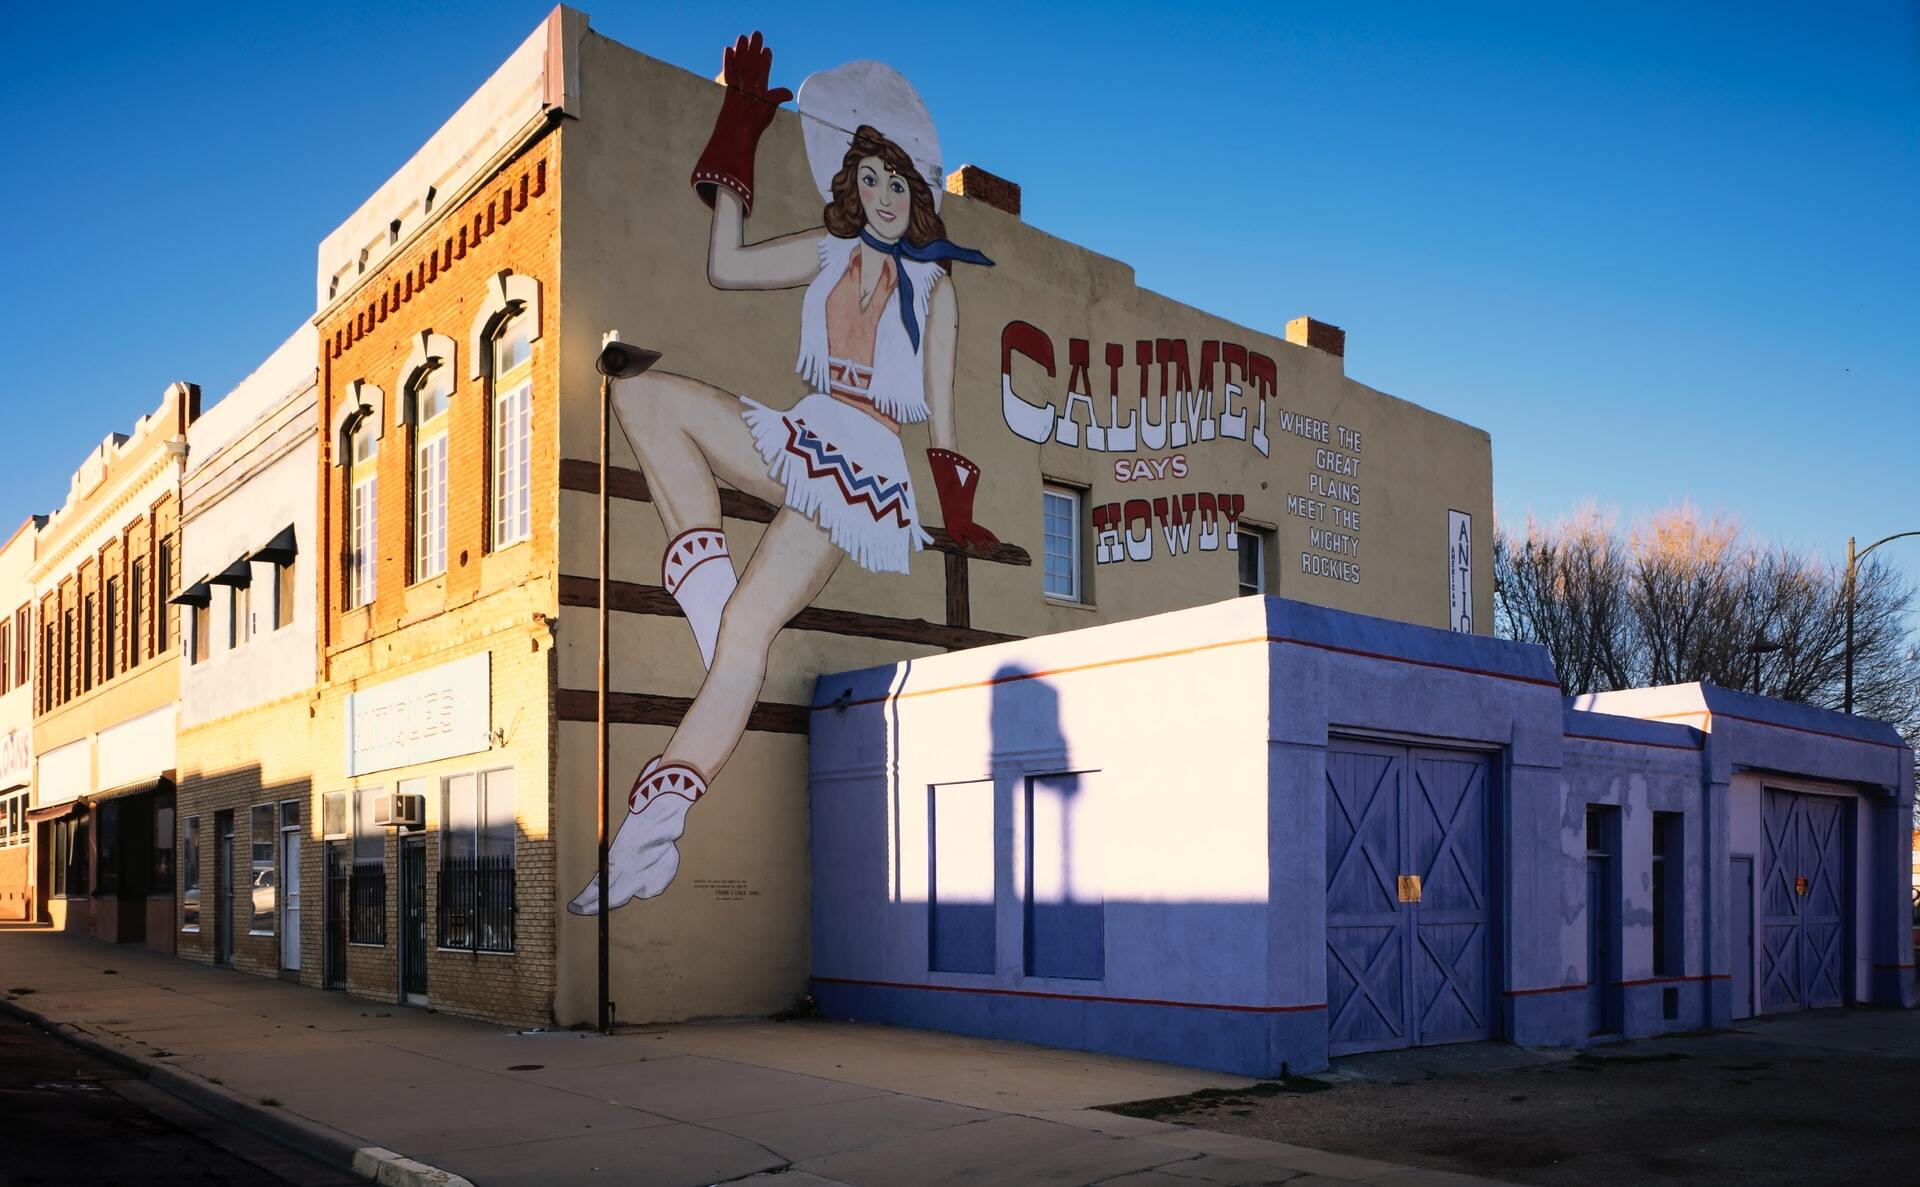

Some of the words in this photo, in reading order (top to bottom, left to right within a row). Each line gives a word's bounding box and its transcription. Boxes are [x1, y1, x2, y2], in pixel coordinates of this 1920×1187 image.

[1001, 320, 1277, 458] CALUMET
[1280, 409, 1330, 443] WHERE
[1337, 426, 1361, 453] THE
[1114, 454, 1188, 483] SAYS
[1316, 448, 1361, 478] GREAT
[1309, 473, 1361, 505] PLAINS
[1092, 492, 1245, 565] HOWDY
[1287, 493, 1326, 522] MEET
[1333, 505, 1361, 531] THE
[1310, 527, 1360, 558] MIGHTY
[1302, 552, 1361, 584] ROCKIES
[0, 732, 29, 778] OANS
